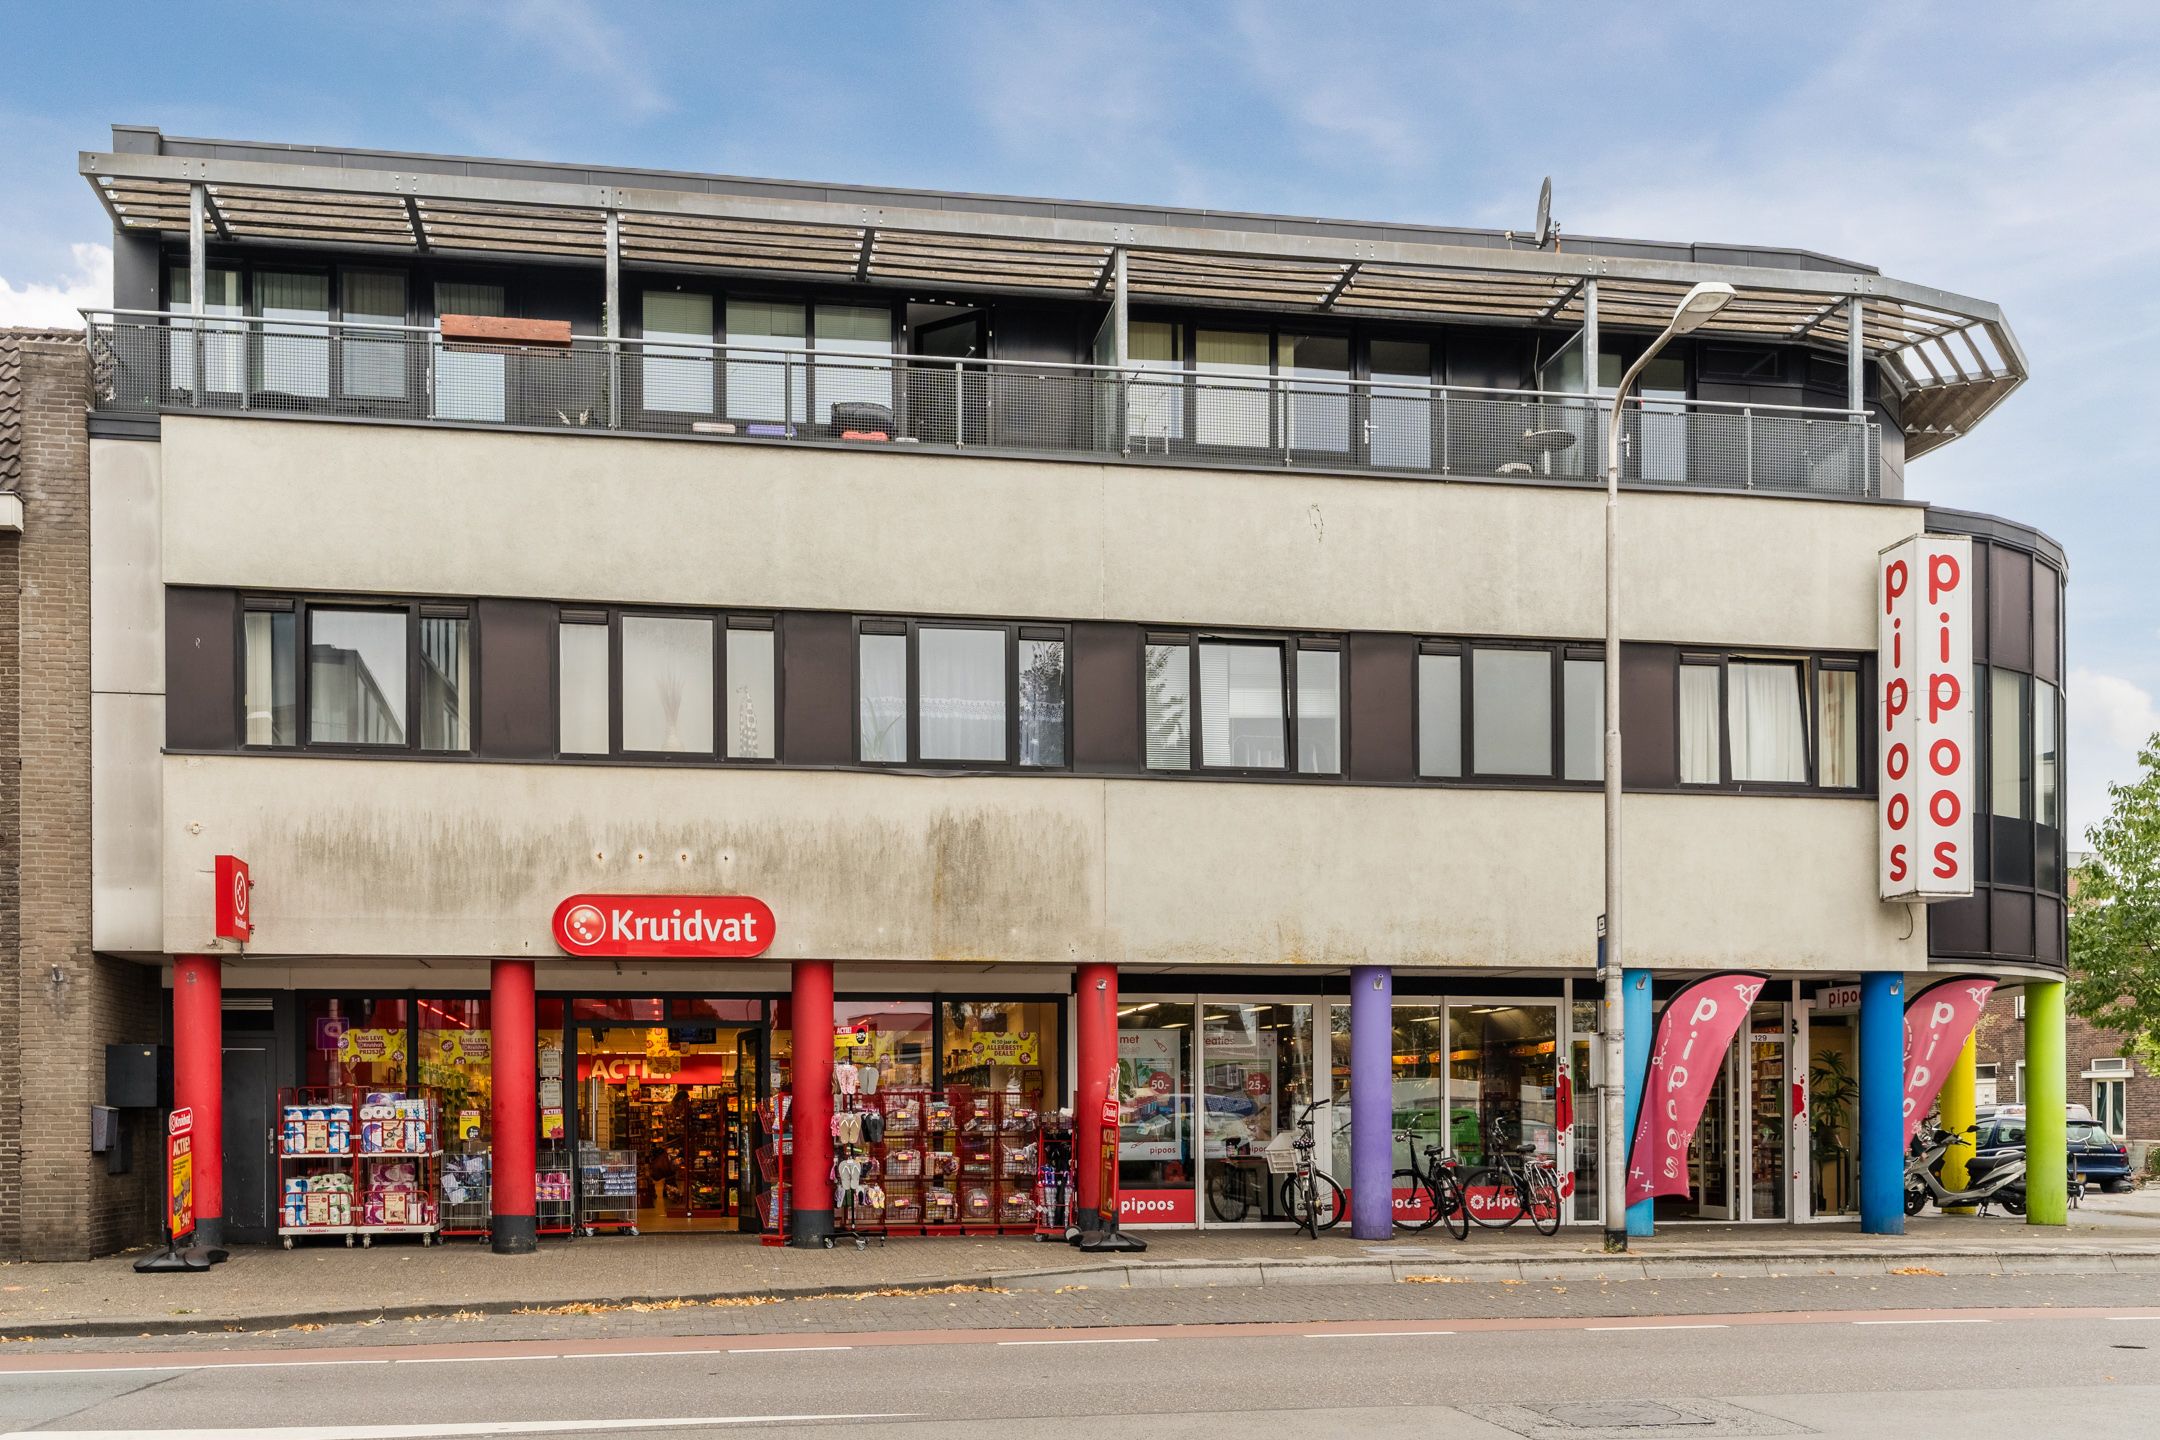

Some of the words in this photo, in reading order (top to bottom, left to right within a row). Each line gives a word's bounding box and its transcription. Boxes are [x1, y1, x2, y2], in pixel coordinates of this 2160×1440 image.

[1885, 559, 1909, 882] pipoos
[1928, 554, 1961, 879] pipoos
[611, 908, 758, 942] Kruidvat
[1119, 1035, 1140, 1044] met
[1204, 1036, 1235, 1045] eaties
[1903, 1002, 1955, 1118] pipo
[1663, 997, 1718, 1179] pipoos
[1149, 1145, 1176, 1155] pipoos
[1120, 1197, 1175, 1214] pipoos
[1391, 1197, 1422, 1209] oos
[1486, 1195, 1521, 1210] pipo
